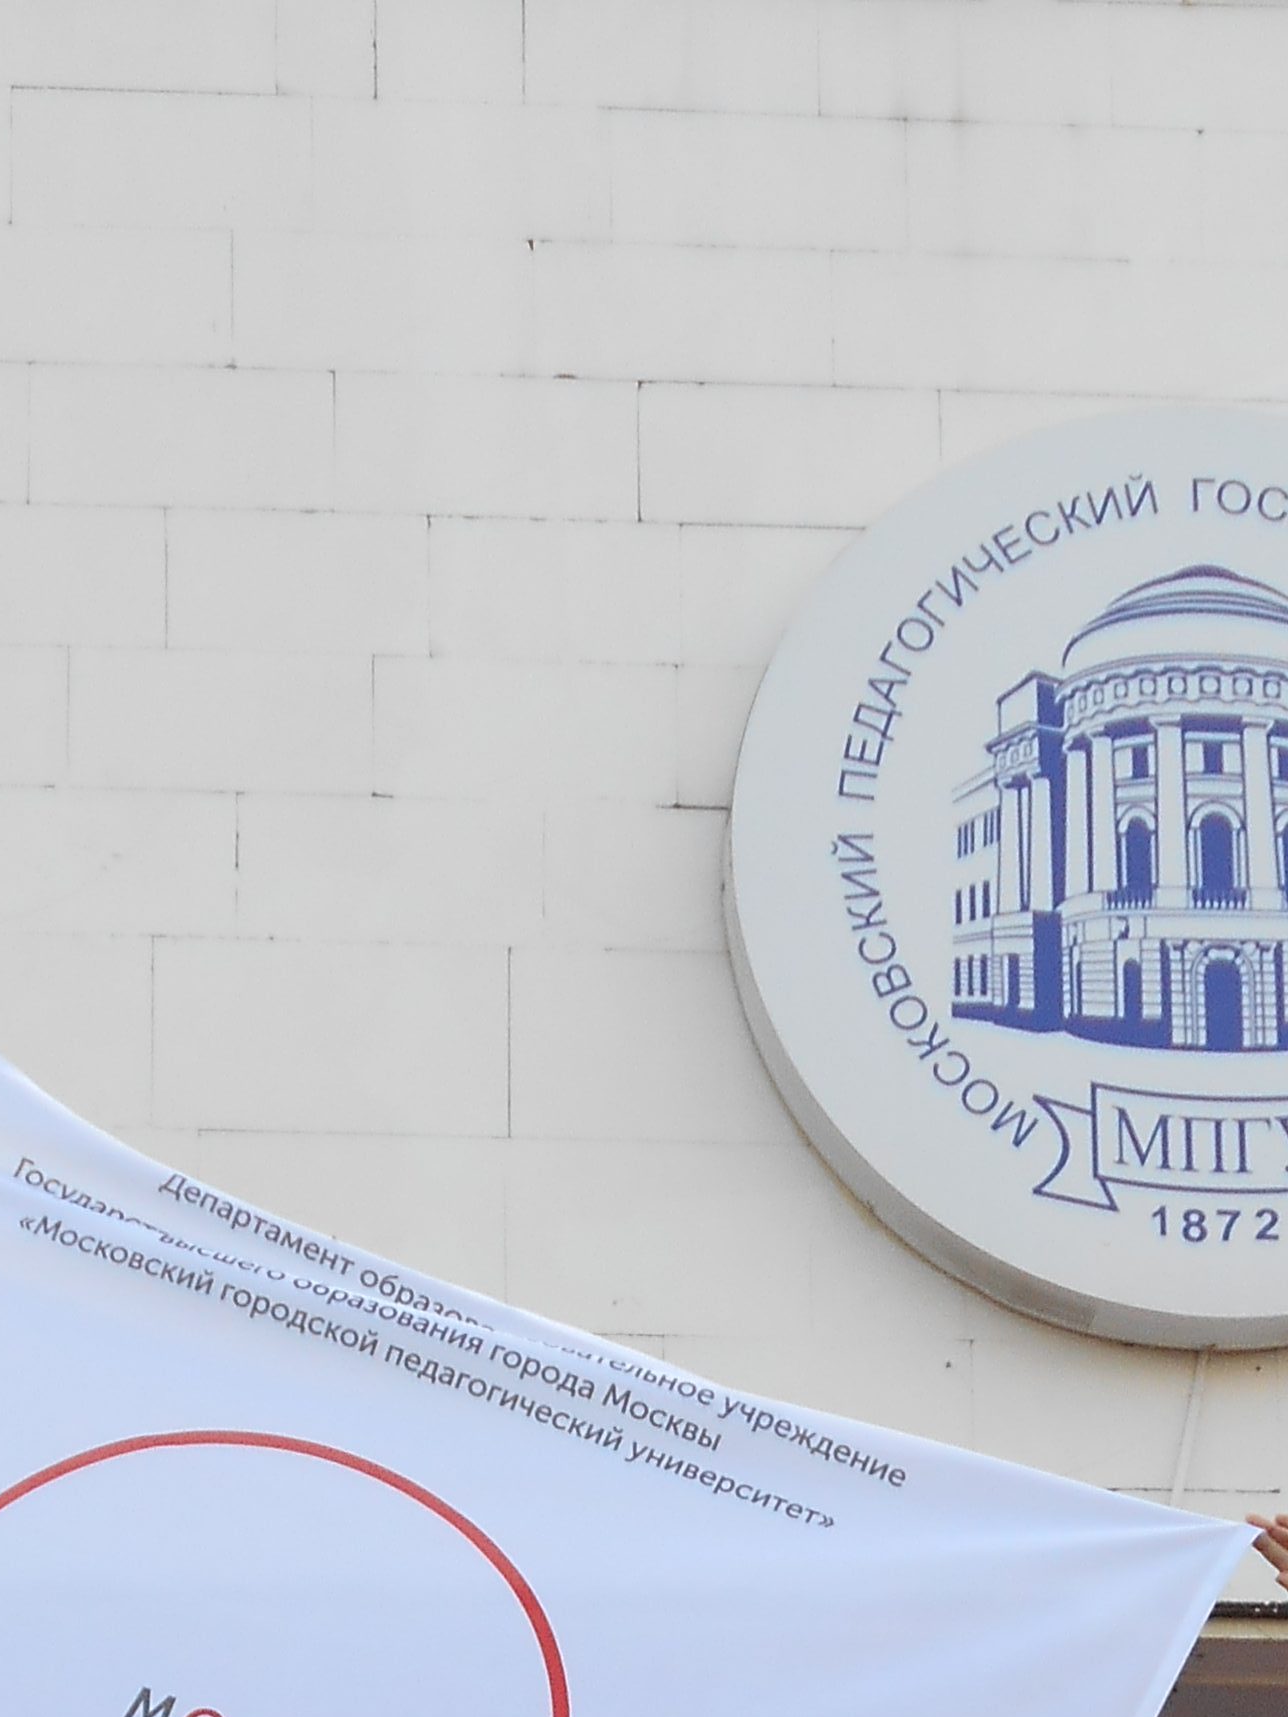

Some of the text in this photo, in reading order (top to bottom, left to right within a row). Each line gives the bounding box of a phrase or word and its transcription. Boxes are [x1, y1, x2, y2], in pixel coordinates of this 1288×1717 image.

[837, 473, 1159, 802] ПЕДАГОГИЧЕСКИЙ
[828, 833, 1041, 1150] МОСКОВСКИЙ
[158, 1173, 355, 1276] Департамент
[1153, 1206, 1281, 1245] 1872
[19, 1215, 835, 1531] «Московский городской педагогический университет»
[489, 1343, 596, 1400] города
[601, 1382, 722, 1452] Москвы
[716, 1396, 907, 1488] учреждение
